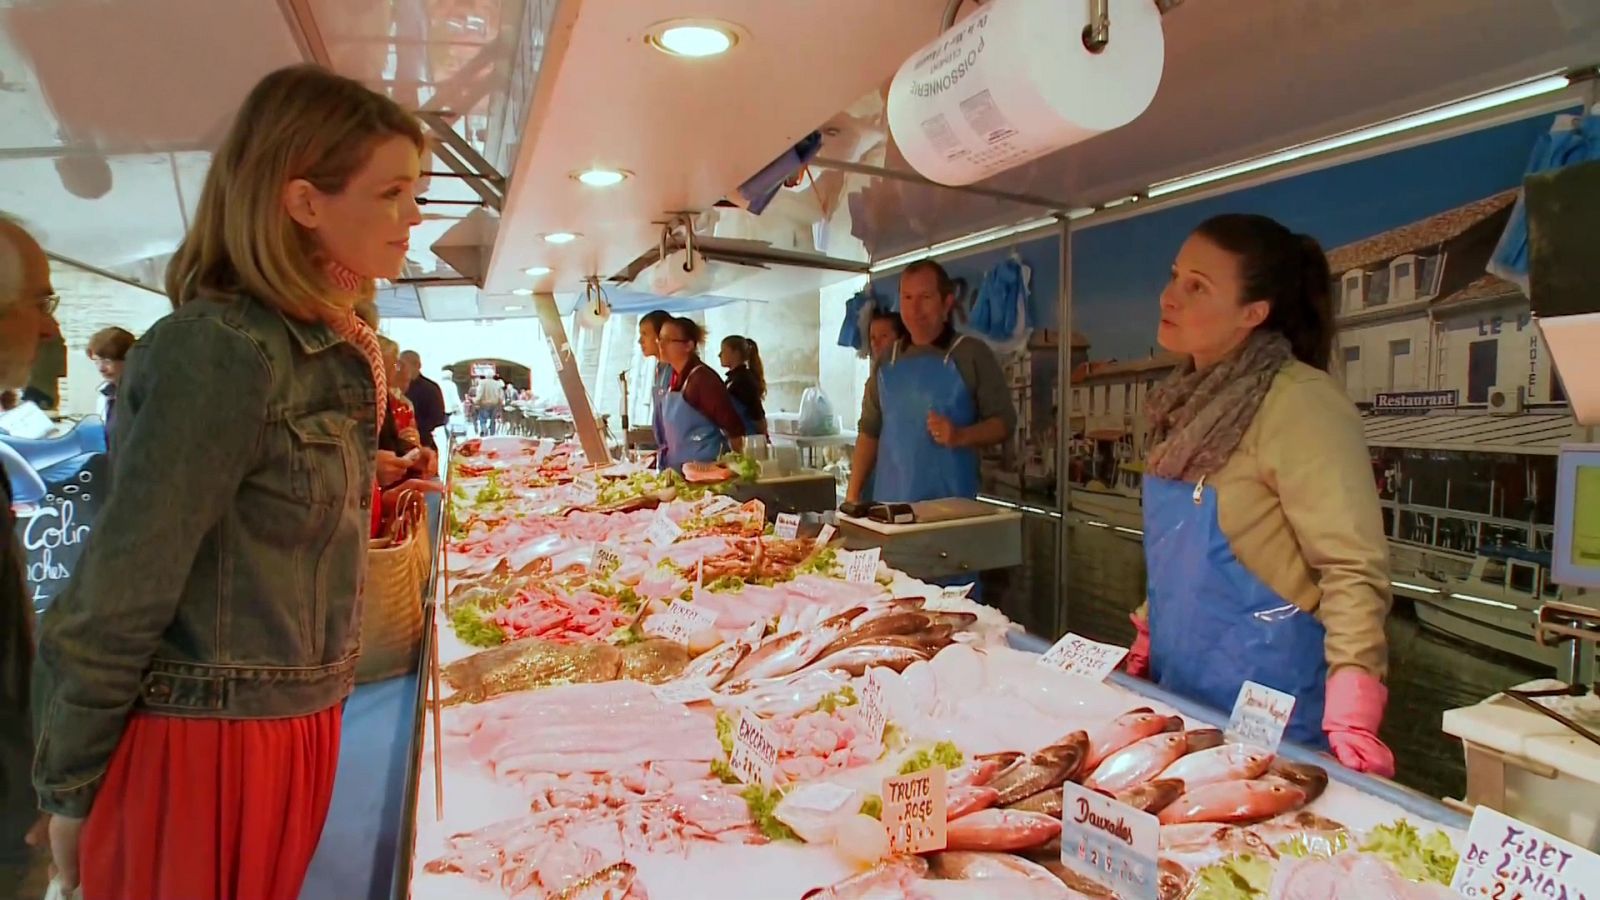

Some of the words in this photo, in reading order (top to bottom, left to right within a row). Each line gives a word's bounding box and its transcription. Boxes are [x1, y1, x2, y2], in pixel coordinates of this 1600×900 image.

[1478, 315, 1503, 336] LE
[1378, 392, 1454, 408] Restaurant
[1467, 842, 1489, 865] DE
